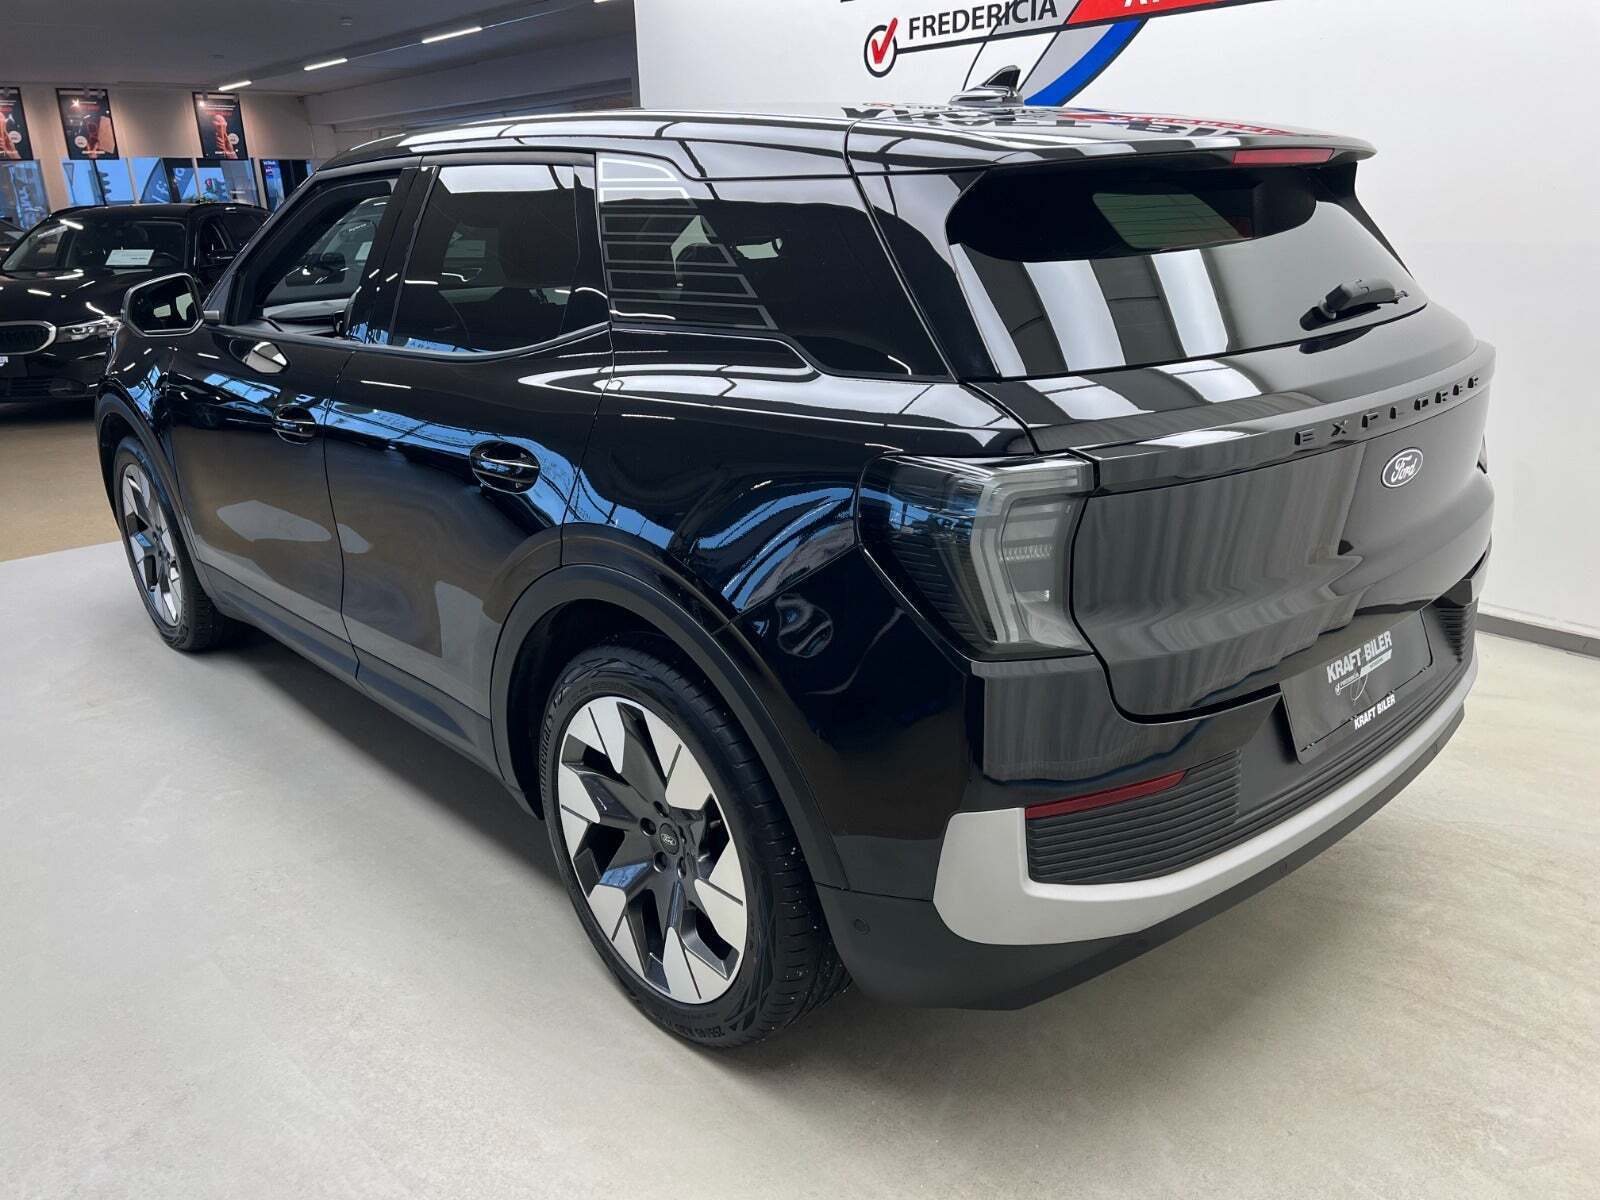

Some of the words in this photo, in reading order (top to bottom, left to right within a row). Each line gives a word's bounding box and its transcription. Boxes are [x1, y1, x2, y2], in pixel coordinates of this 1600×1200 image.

[908, 0, 1058, 40] FREDERICIA
[1326, 648, 1362, 684] KRAFT
[1364, 630, 1393, 661] BILER
[1354, 707, 1378, 730] KRAFT
[1377, 693, 1396, 714] BILER
